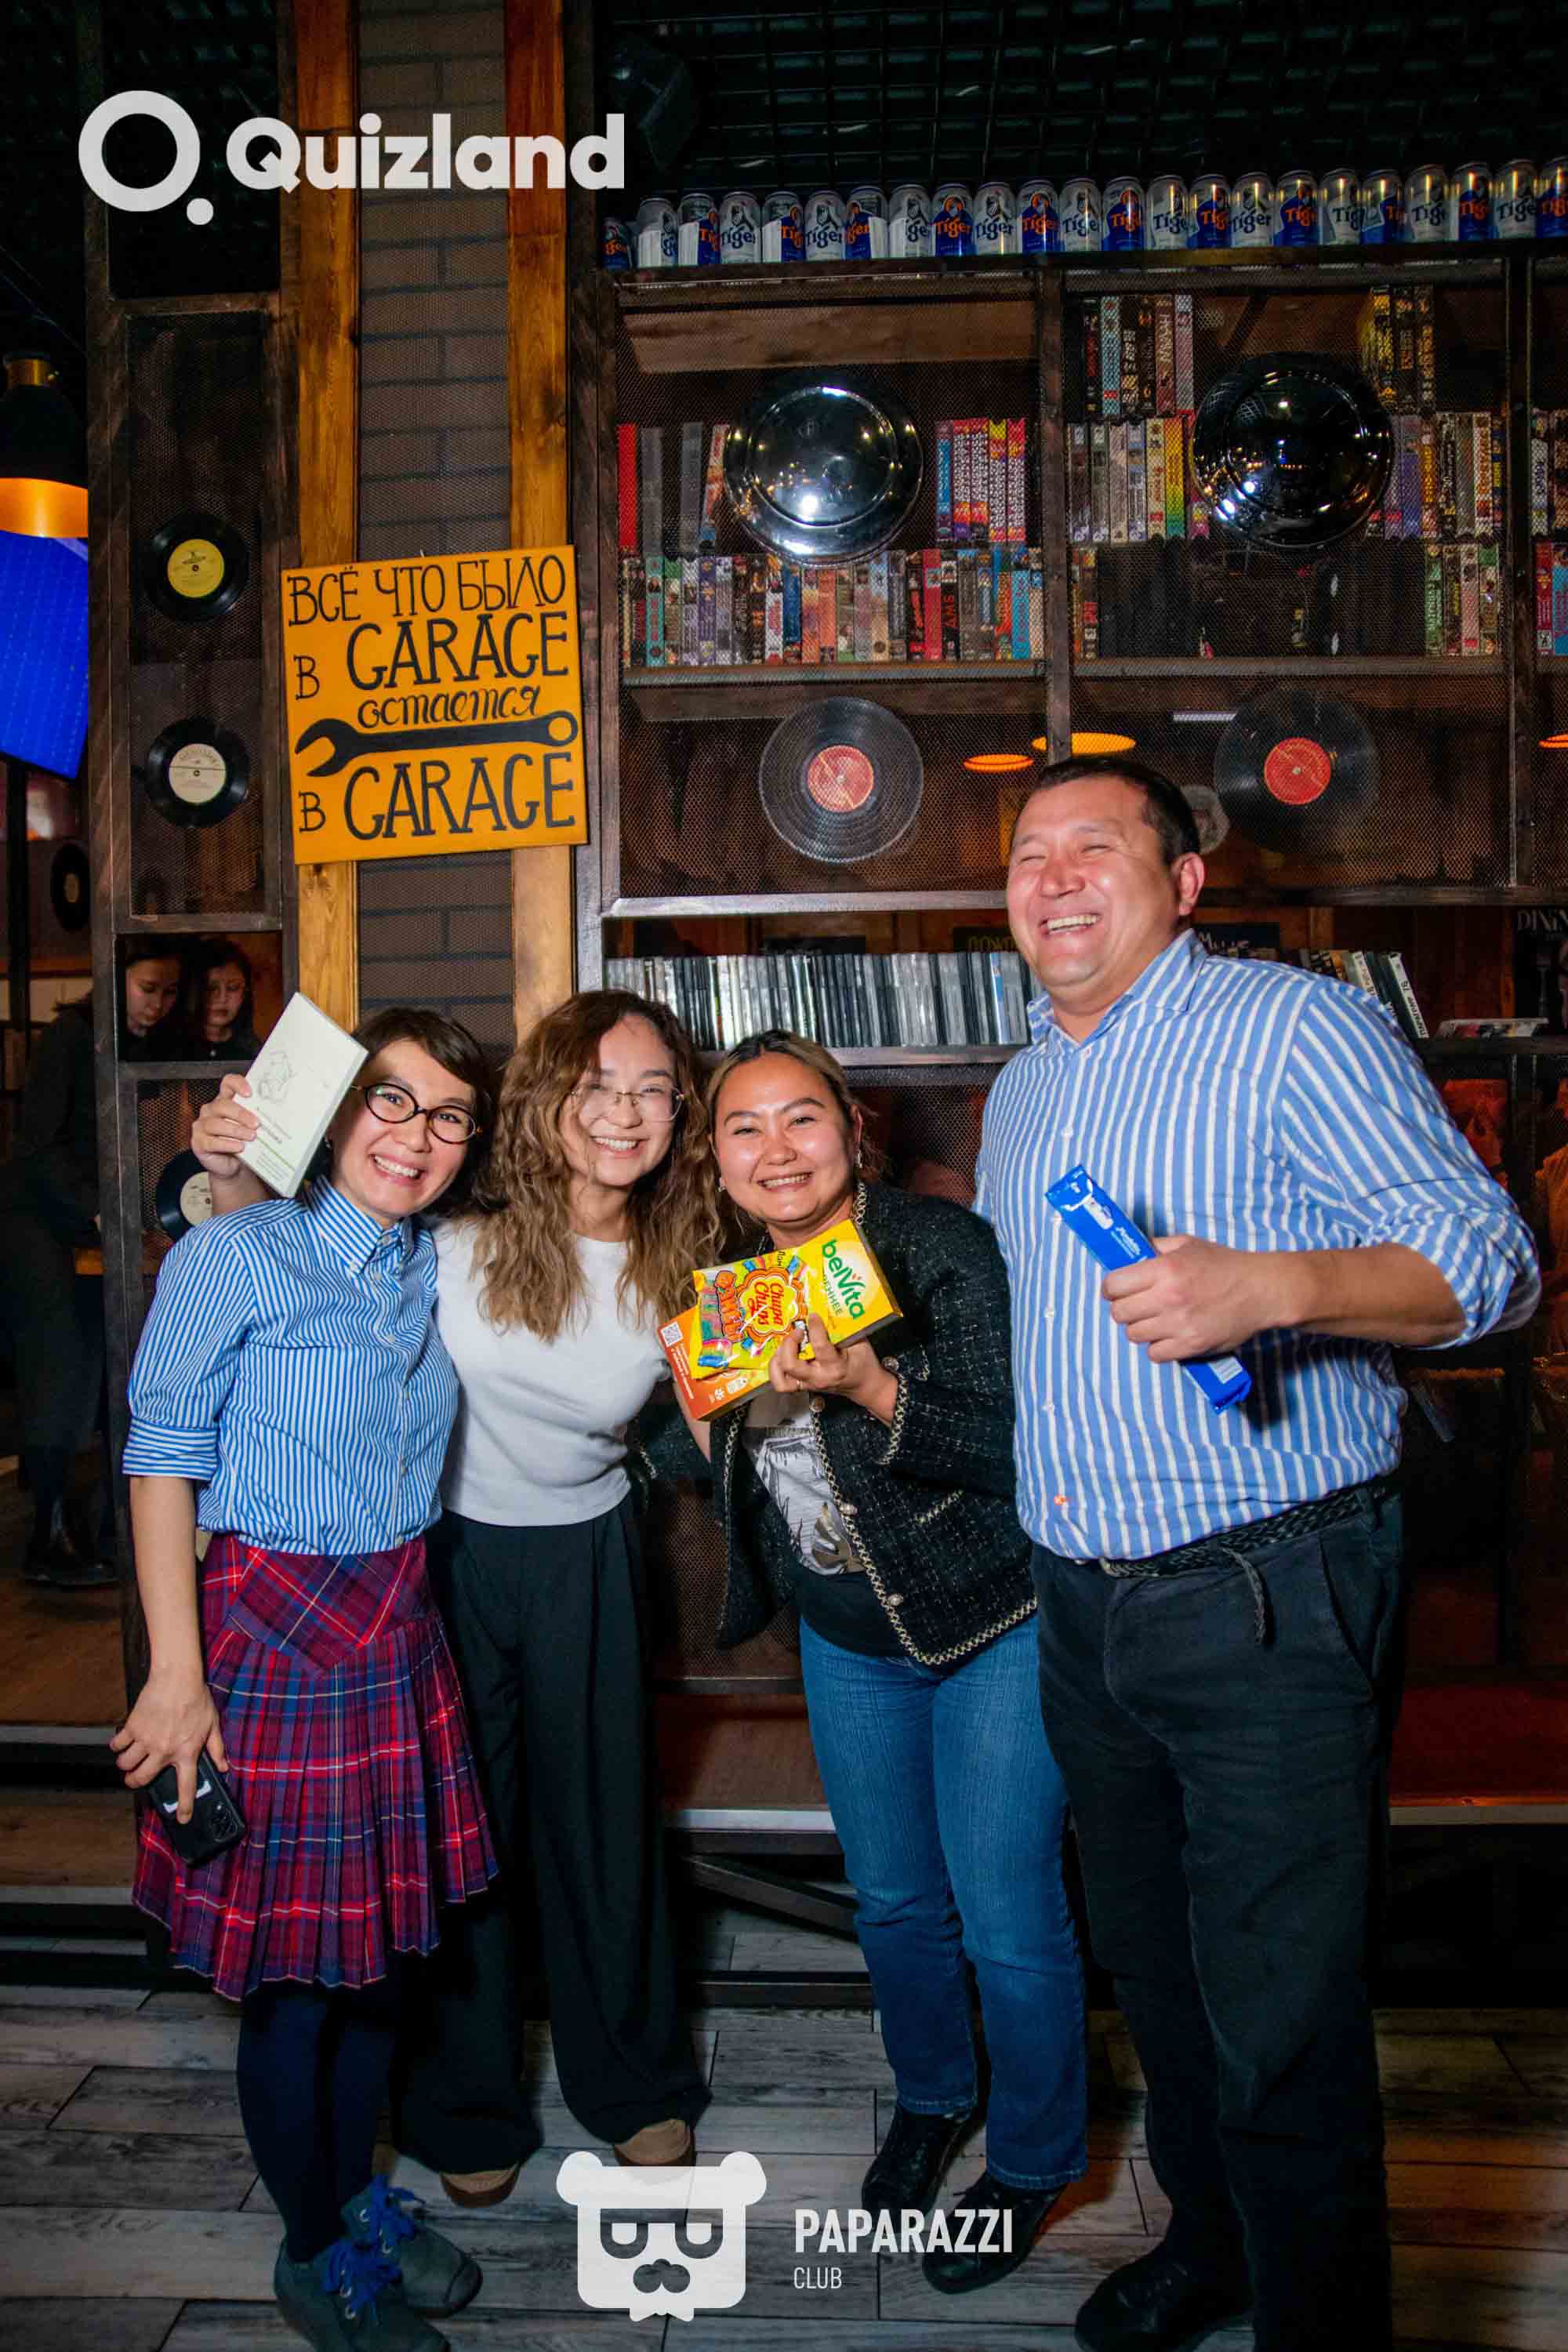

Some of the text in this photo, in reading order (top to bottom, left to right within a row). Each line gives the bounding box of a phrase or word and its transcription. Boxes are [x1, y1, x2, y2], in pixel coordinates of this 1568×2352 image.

[1232, 208, 1271, 233] Tiger
[287, 554, 565, 627] ВСЁ ЧТО БЫЛО
[293, 611, 568, 700] В GARAGE
[358, 685, 541, 728] остается
[299, 752, 575, 840] В GARAGE
[753, 1281, 770, 1326] Chups
[770, 1282, 785, 1326] Chupa
[822, 1238, 866, 1319] belVita
